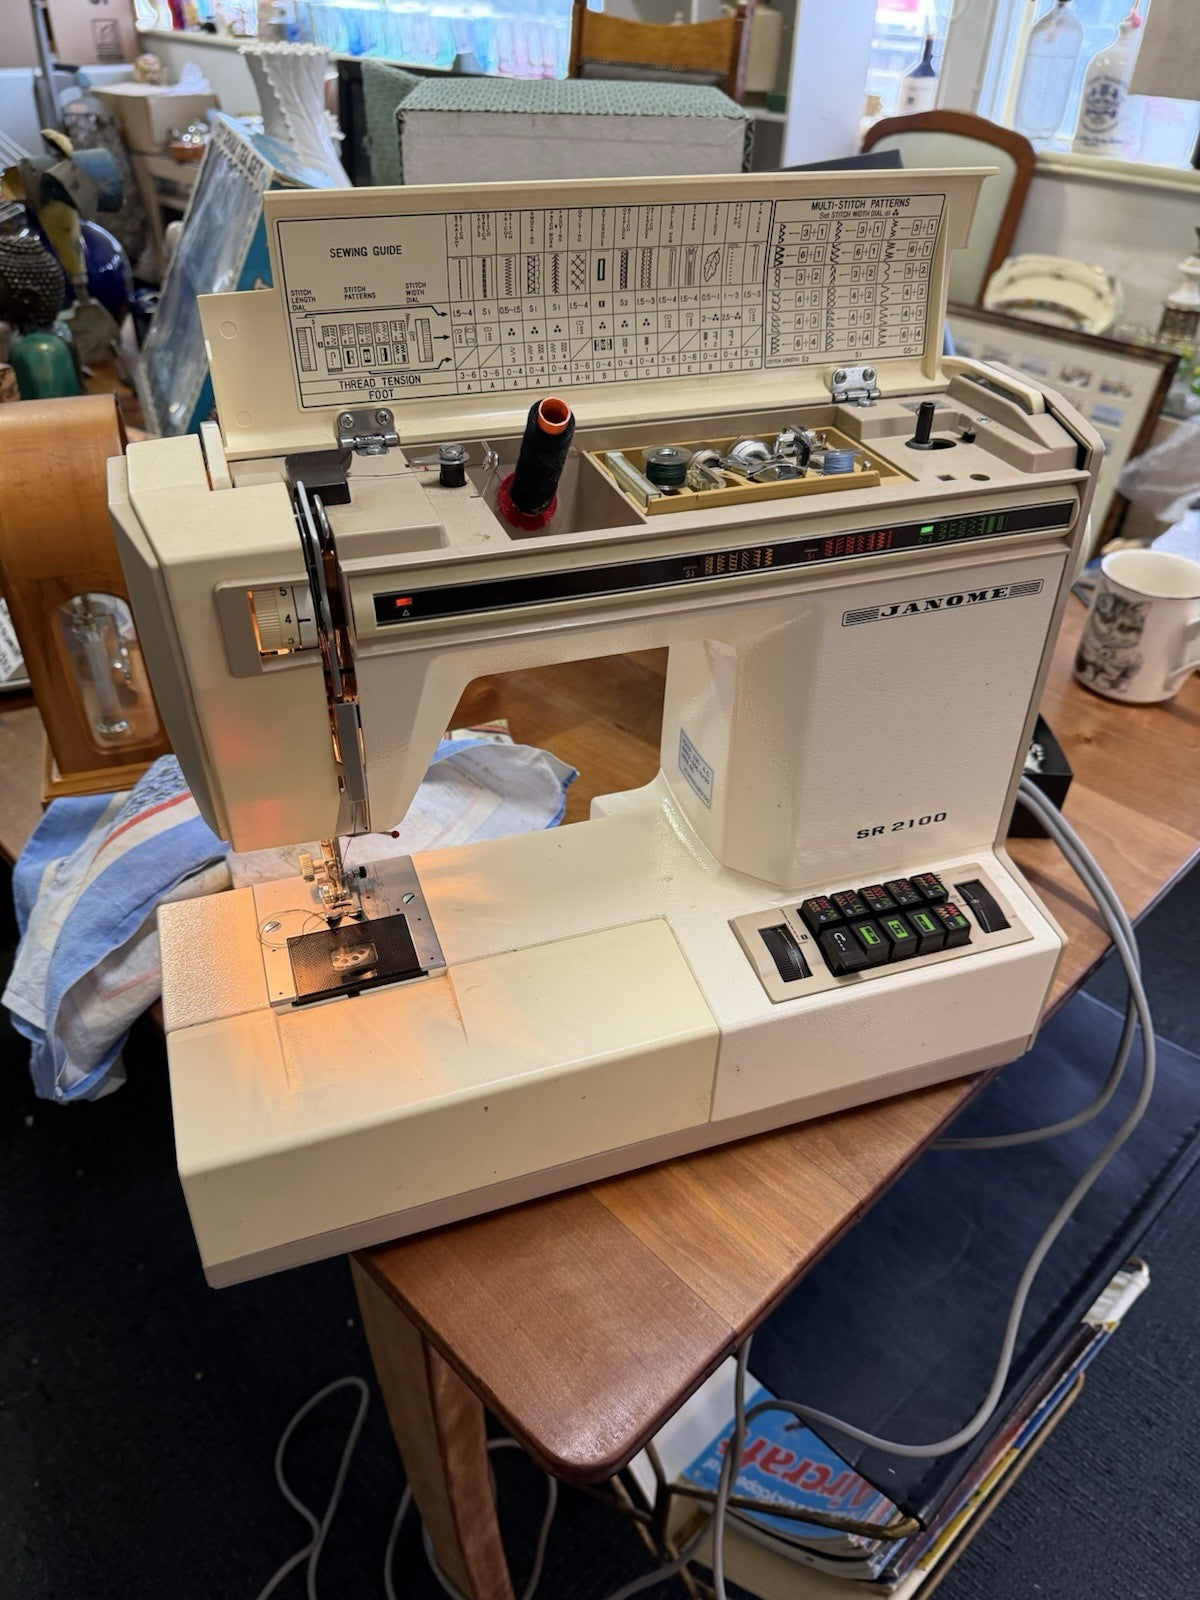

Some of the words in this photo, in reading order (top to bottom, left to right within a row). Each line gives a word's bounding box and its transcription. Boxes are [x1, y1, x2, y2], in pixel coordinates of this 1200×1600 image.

[811, 200, 865, 210] MULTI-STITCH
[871, 198, 910, 208] PATTERNS
[330, 247, 368, 258] SEWING
[373, 245, 402, 256] GUIDE
[339, 379, 376, 390] THREAD
[382, 375, 421, 386] TENSION
[369, 389, 394, 400] FOOT
[279, 587, 287, 596] 5
[881, 587, 1009, 617] JANOME
[285, 614, 292, 624] 4
[856, 826, 885, 840] SR
[892, 812, 947, 832] 2100
